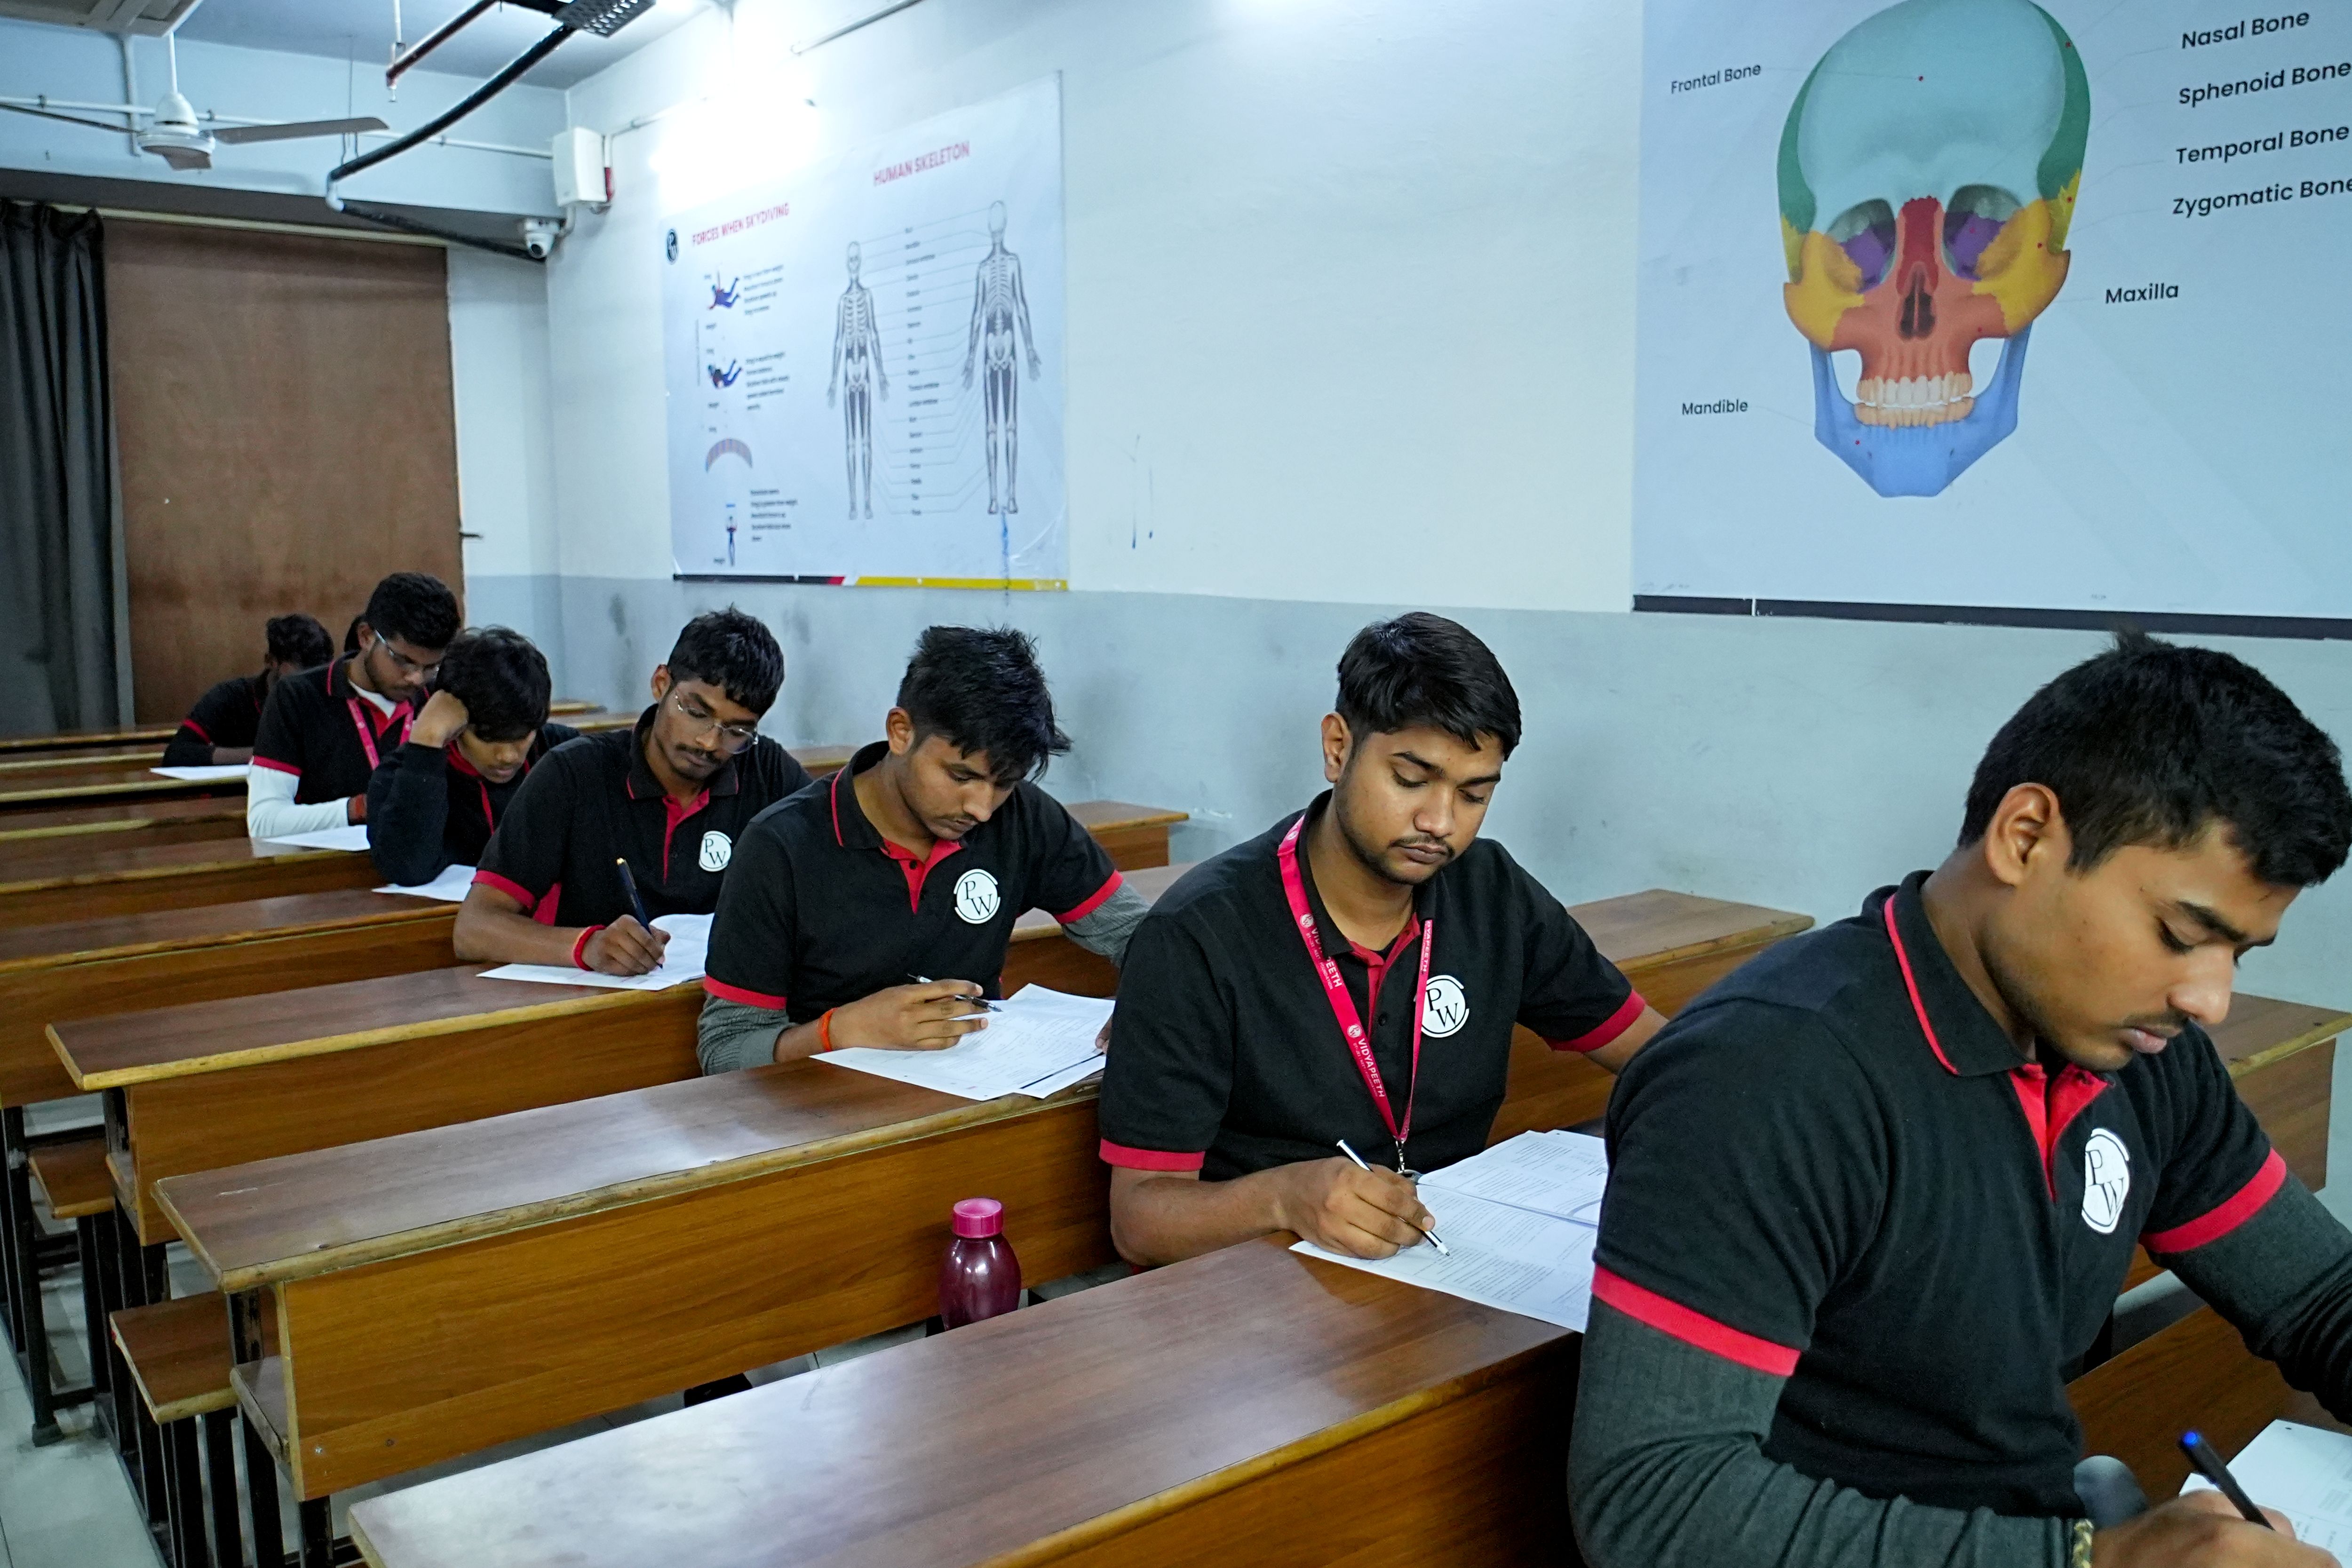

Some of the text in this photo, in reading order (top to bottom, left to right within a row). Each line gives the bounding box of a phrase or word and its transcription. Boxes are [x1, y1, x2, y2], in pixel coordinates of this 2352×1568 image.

[2181, 12, 2310, 49] Nasal Bone
[1671, 64, 1761, 94] Frontal Bone
[2179, 62, 2352, 108] Sphenoid Bone
[874, 141, 969, 186] HUMAN SKELETON
[2176, 126, 2350, 164] Temporal Bone
[2172, 183, 2293, 219] Zygomatic
[692, 202, 789, 246] FORCES WHEN SKYDIVING
[2105, 282, 2179, 304] Maxilla
[1682, 399, 1748, 415] Mandible
[1358, 1038, 1385, 1097] VIDYAPEETH
